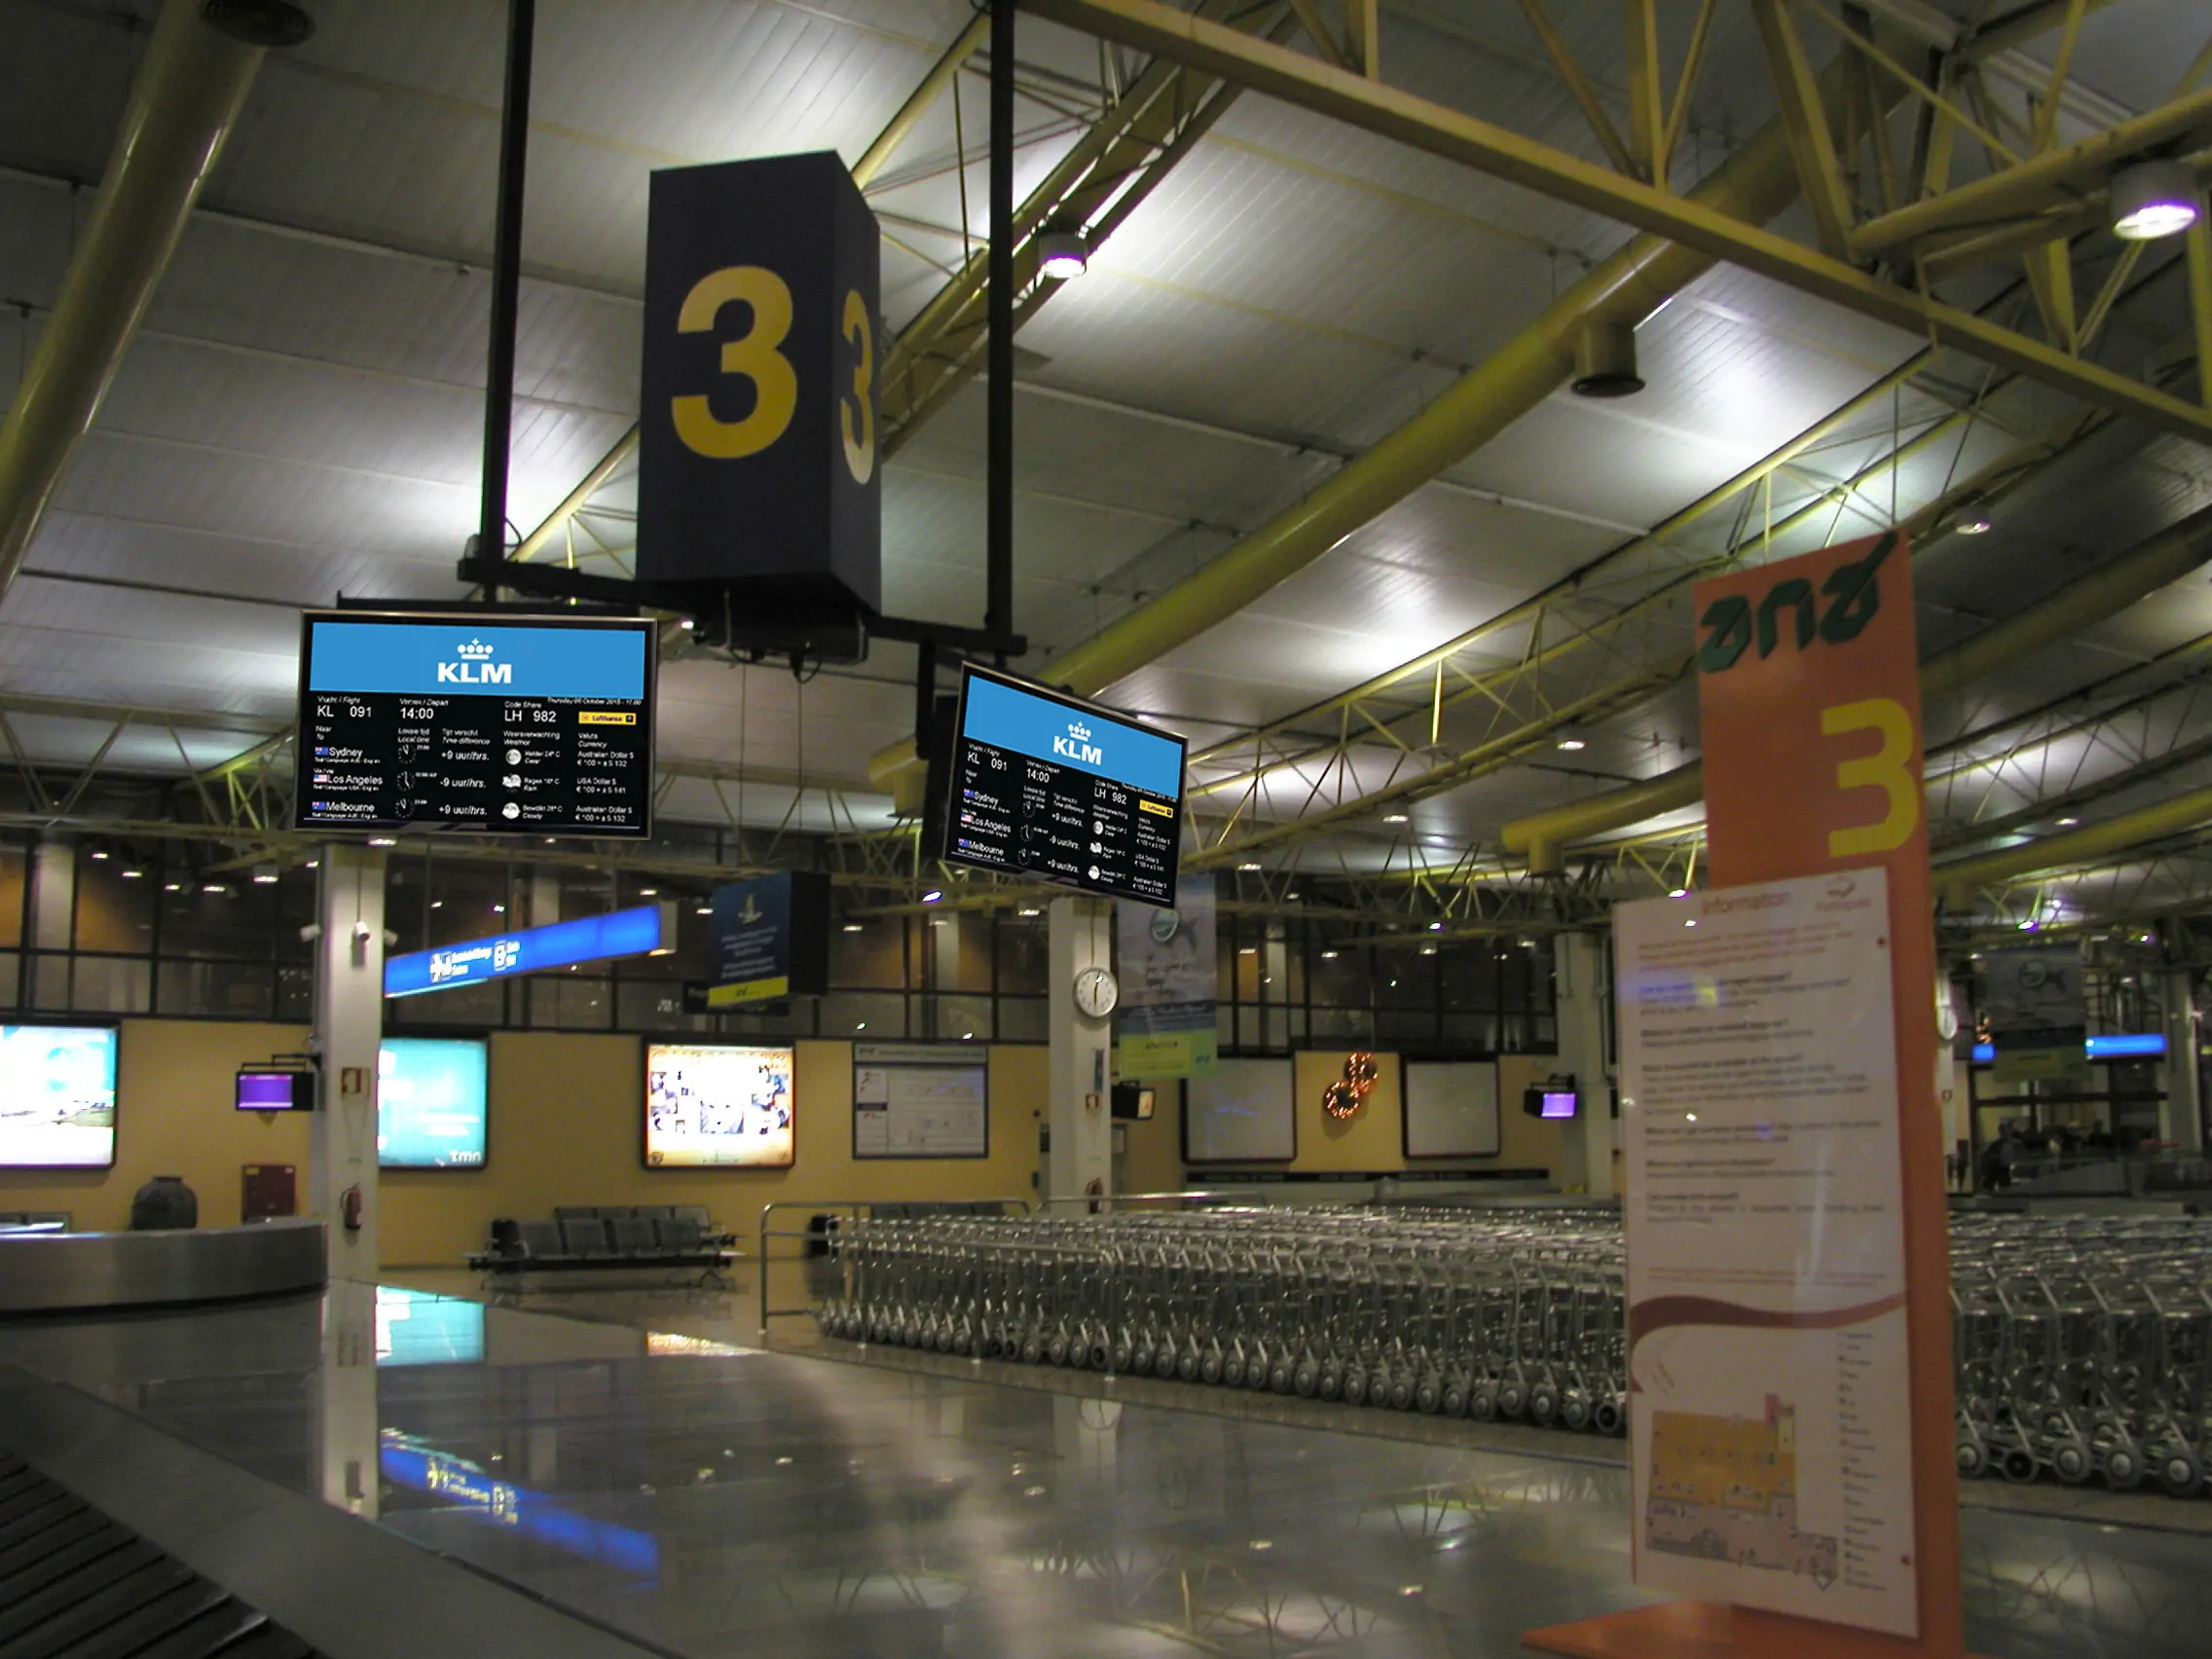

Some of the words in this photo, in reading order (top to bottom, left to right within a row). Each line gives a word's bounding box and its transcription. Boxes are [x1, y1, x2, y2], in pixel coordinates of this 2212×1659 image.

[672, 266, 797, 460] 3
[841, 289, 874, 485] 3
[436, 661, 512, 684] KLM
[316, 704, 334, 717] KL
[349, 705, 372, 718] 091
[399, 707, 433, 719] 14:00
[503, 709, 522, 721] LH
[533, 710, 556, 722] 982
[328, 747, 362, 758] Sydney
[441, 750, 453, 758] +9
[1052, 734, 1102, 766] KLM
[967, 750, 980, 764] KL
[990, 756, 1007, 771] 091
[327, 774, 344, 783] Los
[345, 775, 383, 787] Angeles
[439, 777, 450, 787] -9
[1025, 767, 1050, 783] 14:00
[1821, 698, 1920, 858] 3
[973, 791, 998, 806] Sydney
[1093, 786, 1106, 799] LH
[1111, 791, 1126, 805] 982
[325, 801, 375, 812] Melbourne
[438, 804, 451, 814] +9
[971, 816, 983, 826] Los
[983, 819, 1011, 834] Angeles
[968, 839, 1004, 856] Melbourne
[449, 1149, 482, 1162] tmn
